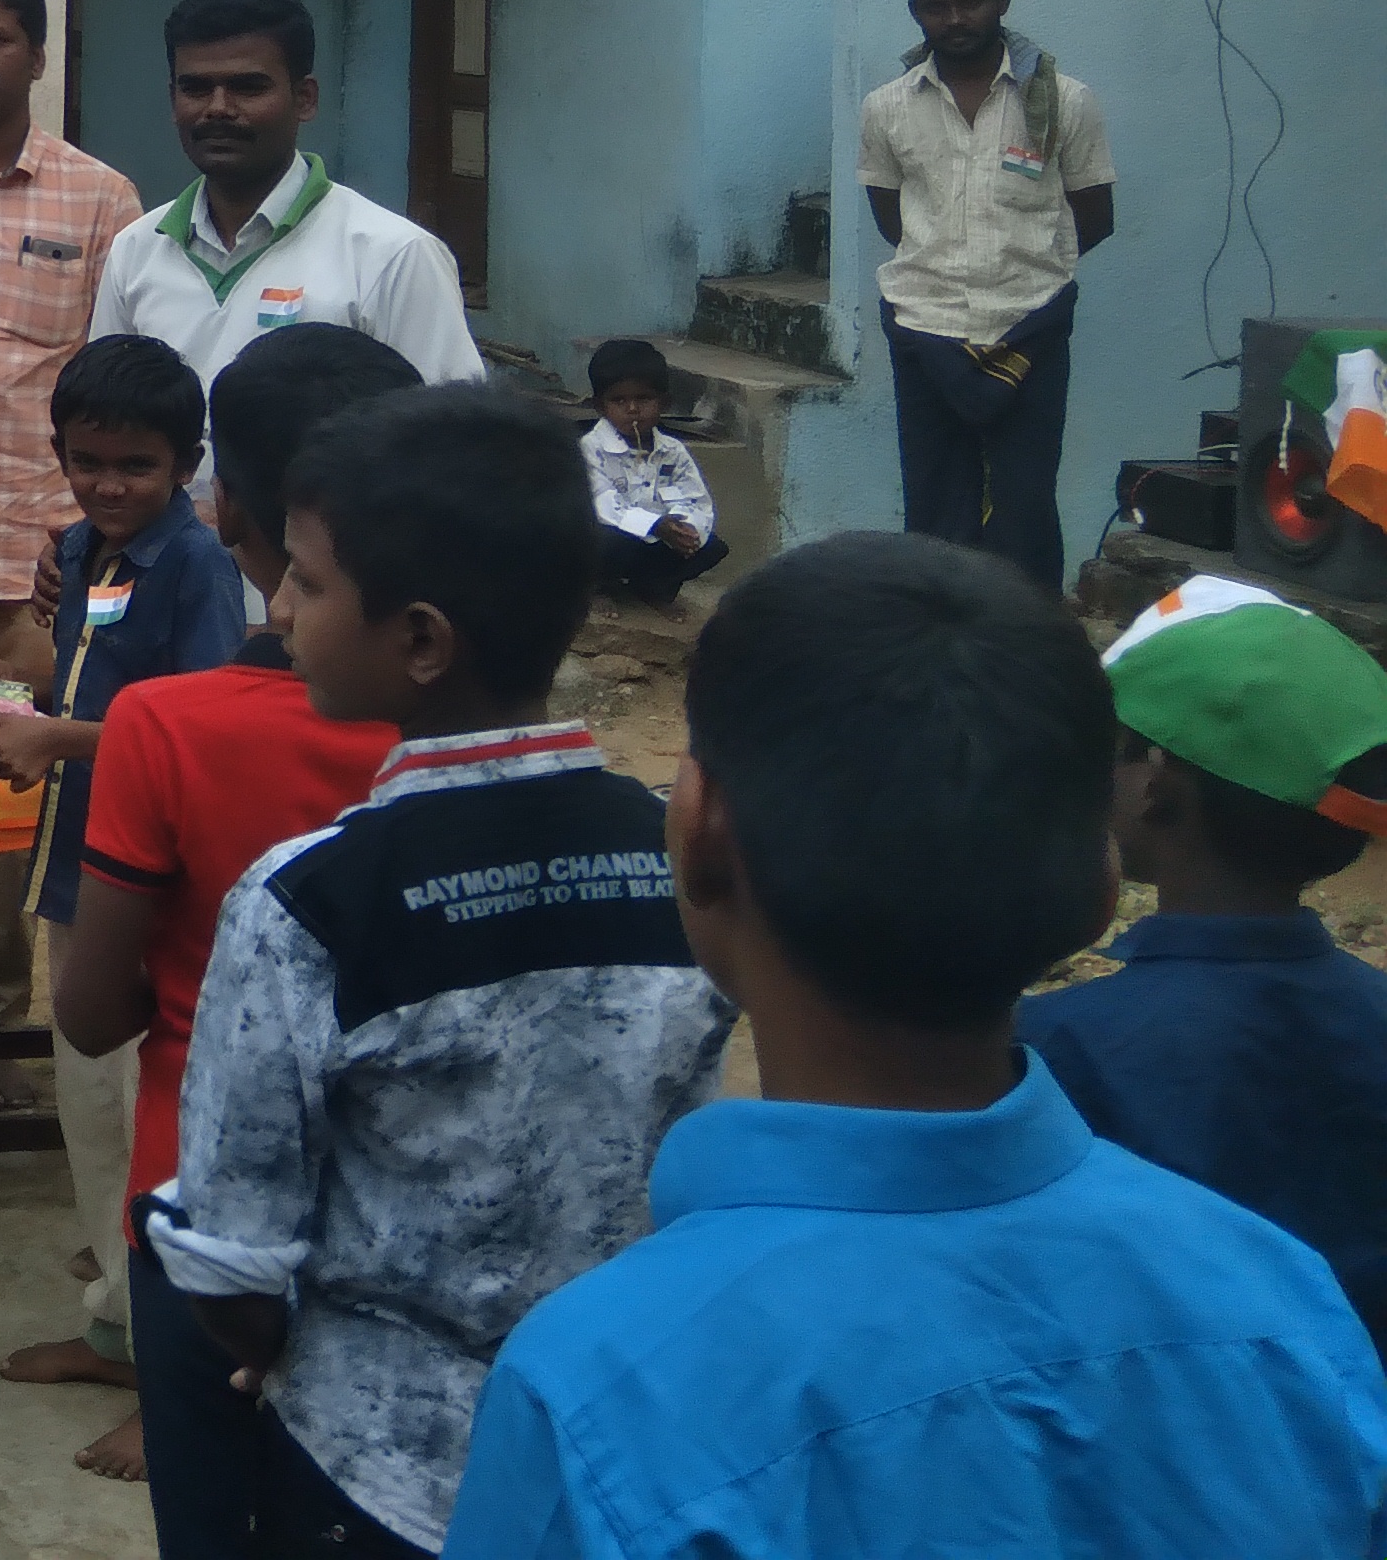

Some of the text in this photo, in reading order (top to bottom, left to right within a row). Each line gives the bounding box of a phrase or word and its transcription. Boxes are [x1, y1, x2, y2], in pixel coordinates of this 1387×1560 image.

[403, 861, 541, 910] RAYMOND
[444, 889, 537, 923] STEPPING
[540, 885, 572, 905] TO
[576, 880, 624, 901] THE
